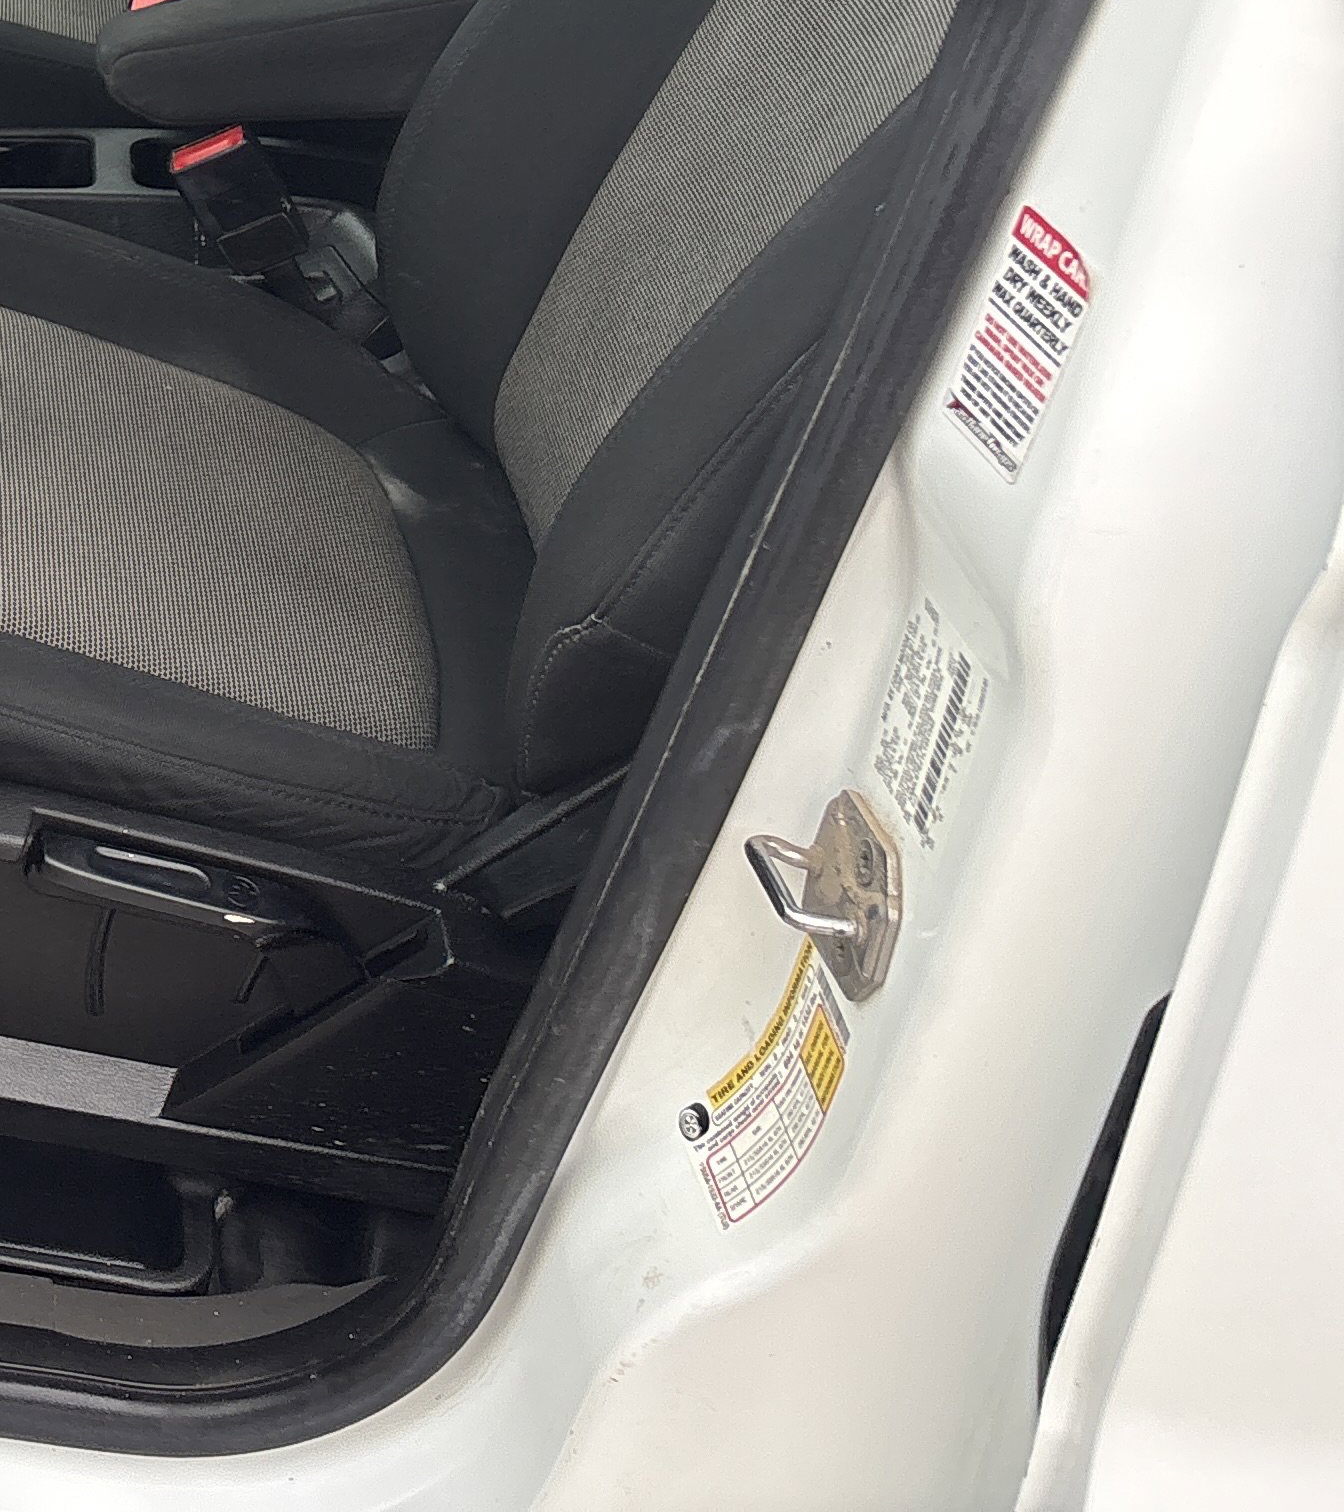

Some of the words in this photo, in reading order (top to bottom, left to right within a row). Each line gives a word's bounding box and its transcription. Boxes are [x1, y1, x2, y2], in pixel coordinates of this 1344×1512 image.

[1020, 213, 1062, 259] WRAP
[711, 1077, 735, 1104] TIRE
[735, 1059, 755, 1083] AND
[753, 1015, 786, 1061] LOADING
